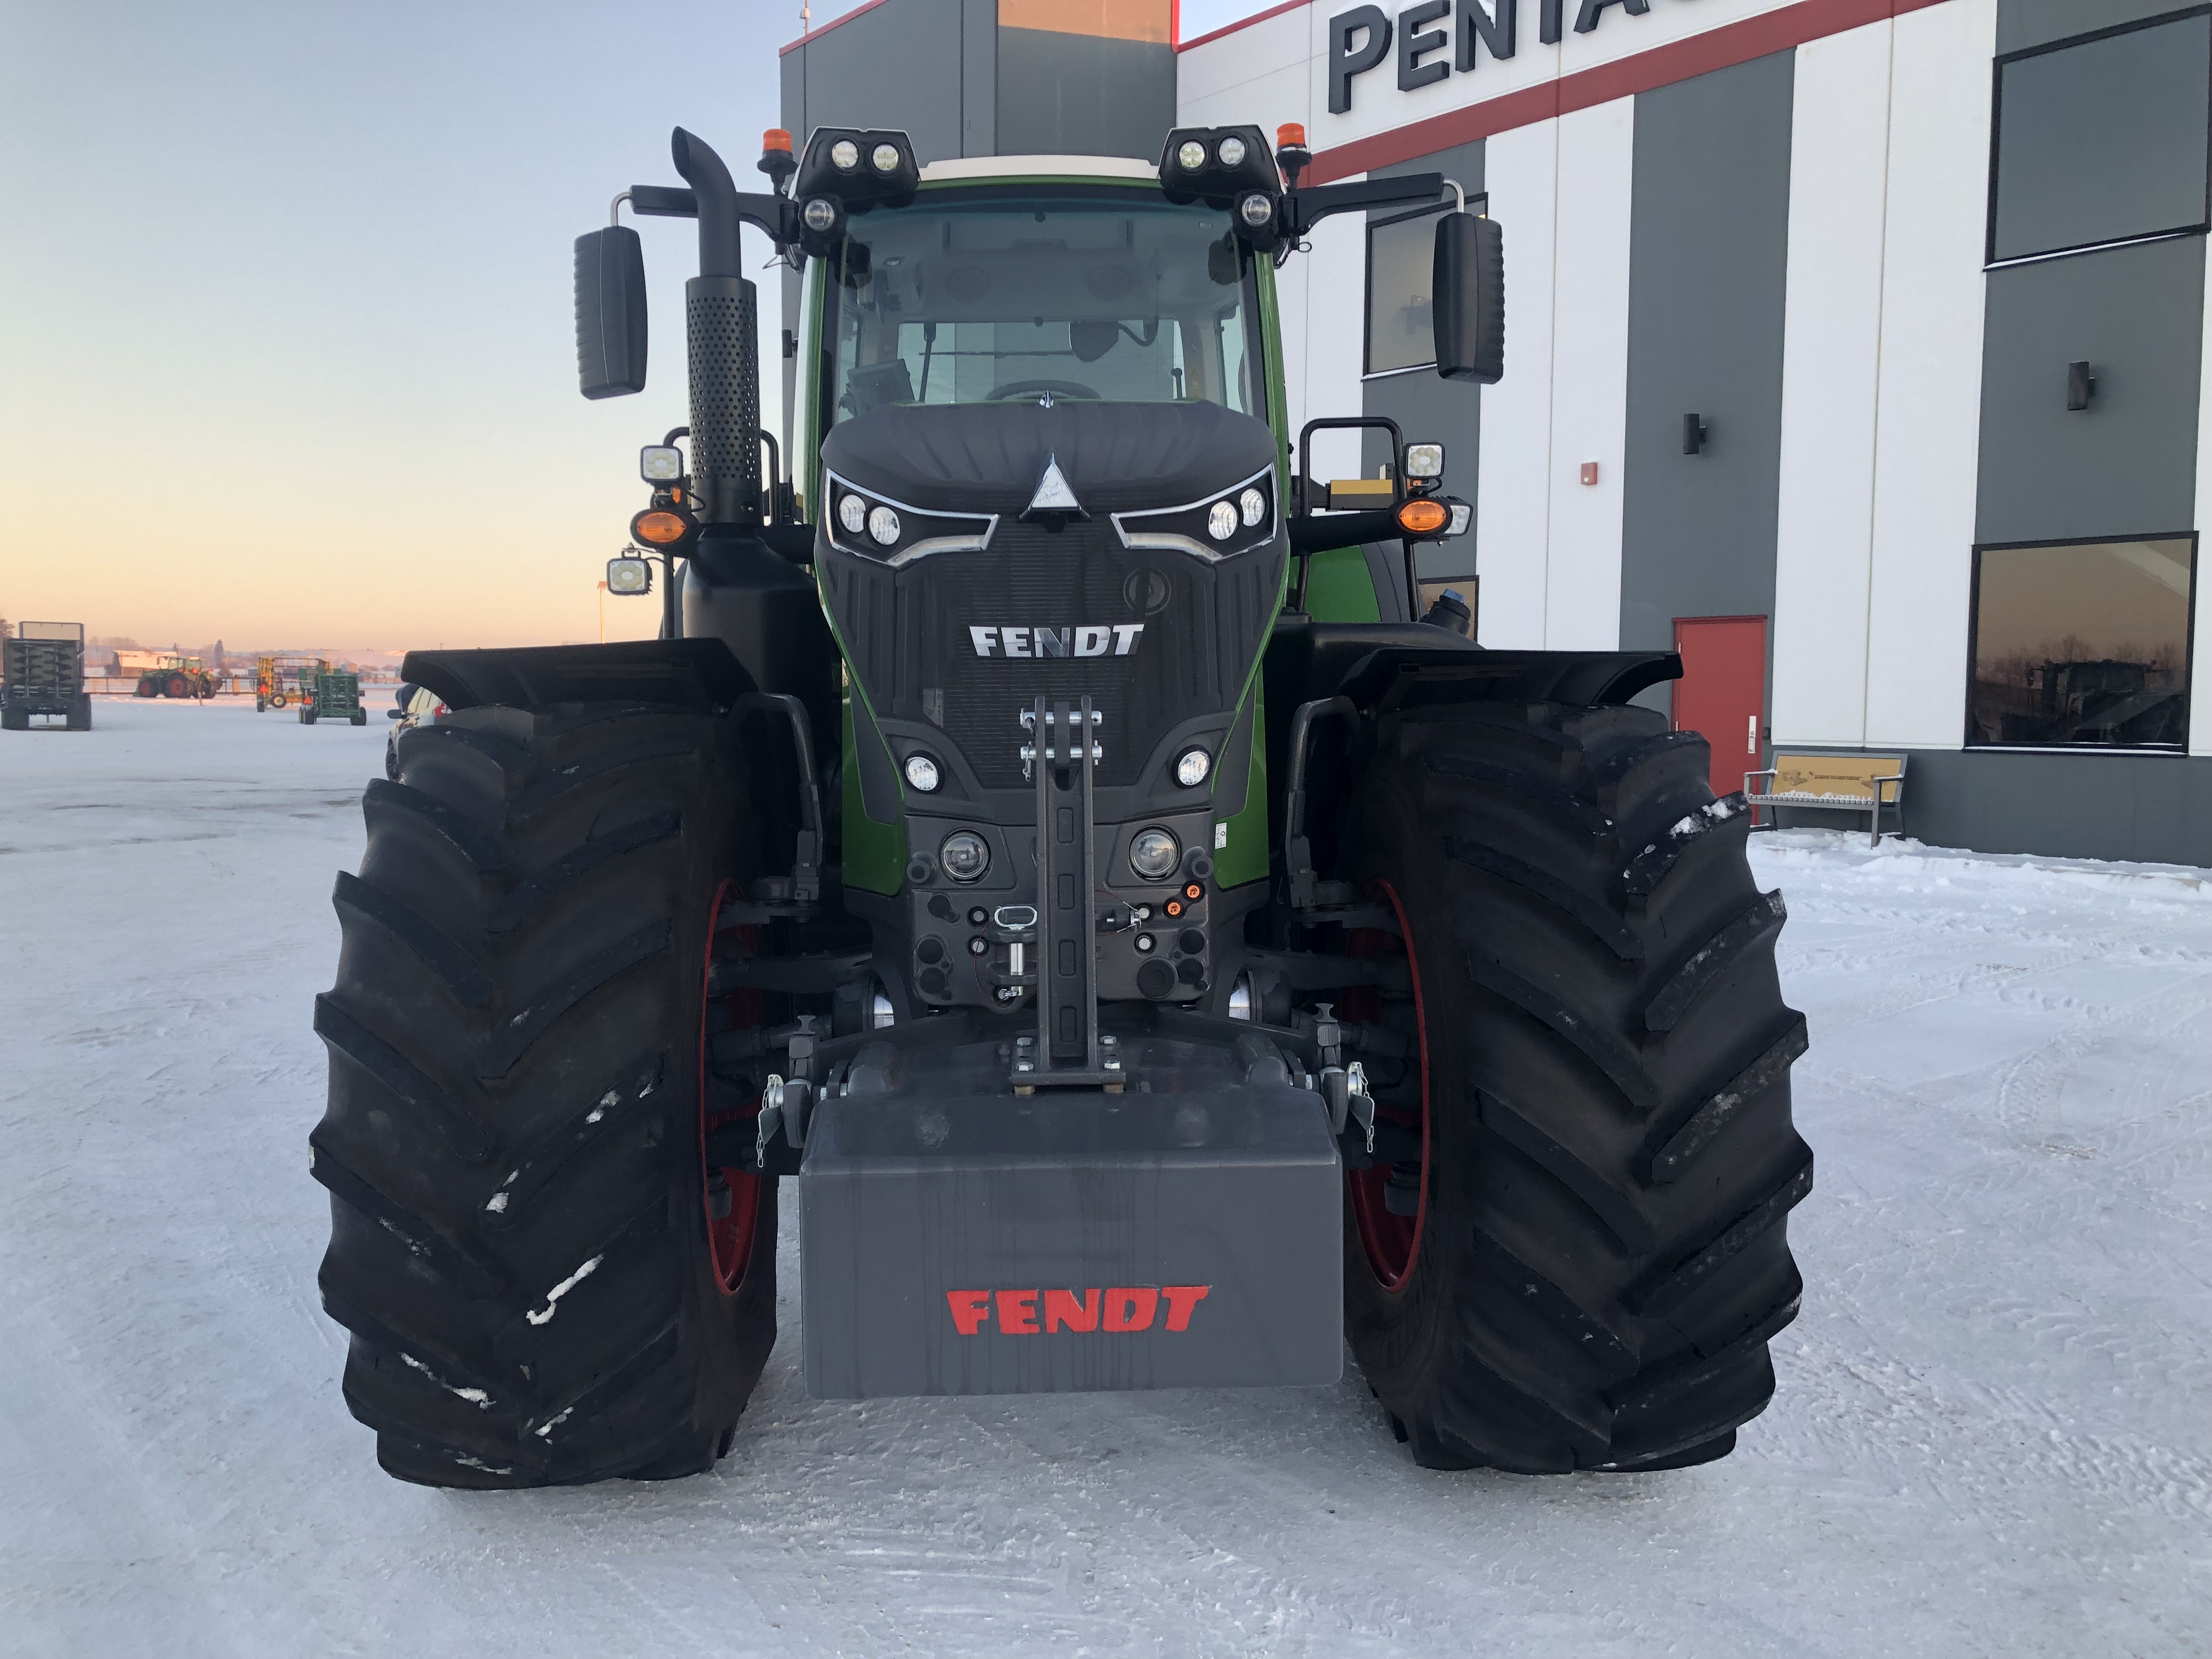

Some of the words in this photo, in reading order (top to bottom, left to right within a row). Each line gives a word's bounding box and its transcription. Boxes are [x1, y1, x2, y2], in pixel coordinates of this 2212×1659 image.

[1328, 0, 1650, 114] PEN
[969, 624, 1144, 657] FENDT
[946, 1285, 1208, 1334] FENDT
